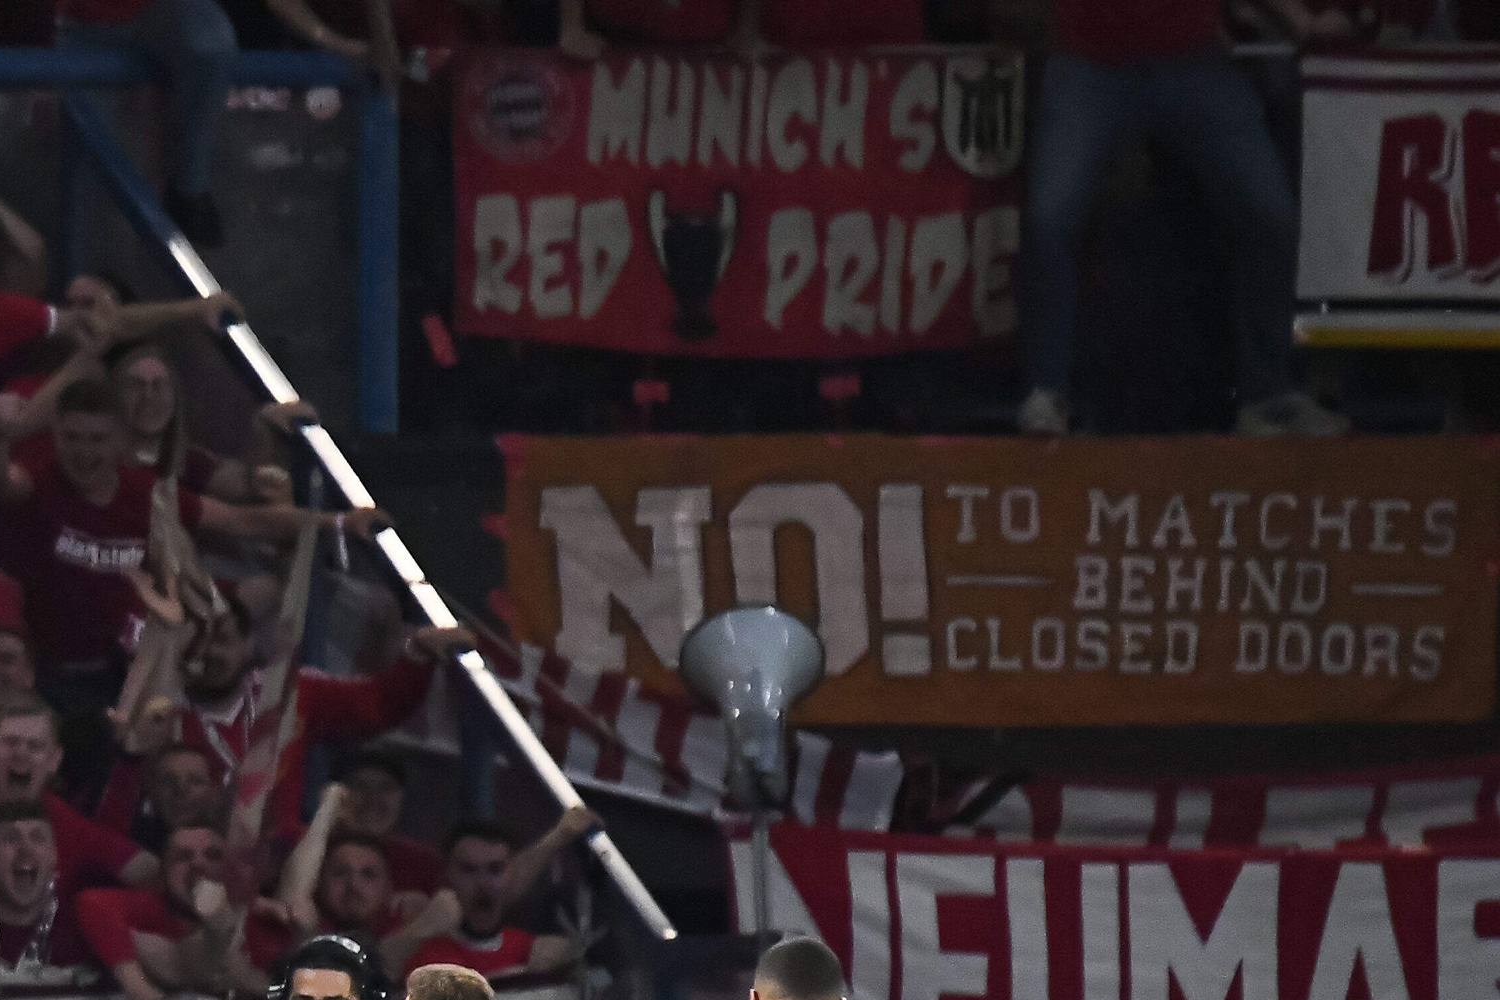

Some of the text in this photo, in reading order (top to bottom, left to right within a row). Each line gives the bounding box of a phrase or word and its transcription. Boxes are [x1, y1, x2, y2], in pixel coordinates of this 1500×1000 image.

[586, 56, 940, 173] MUNICH'S
[473, 193, 1020, 337] RED PRIDE
[946, 485, 1457, 557] TO MATCHES
[539, 480, 932, 678] NO!
[1073, 556, 1328, 615] BEHIND
[945, 617, 1447, 680] CLOSED DOORS
